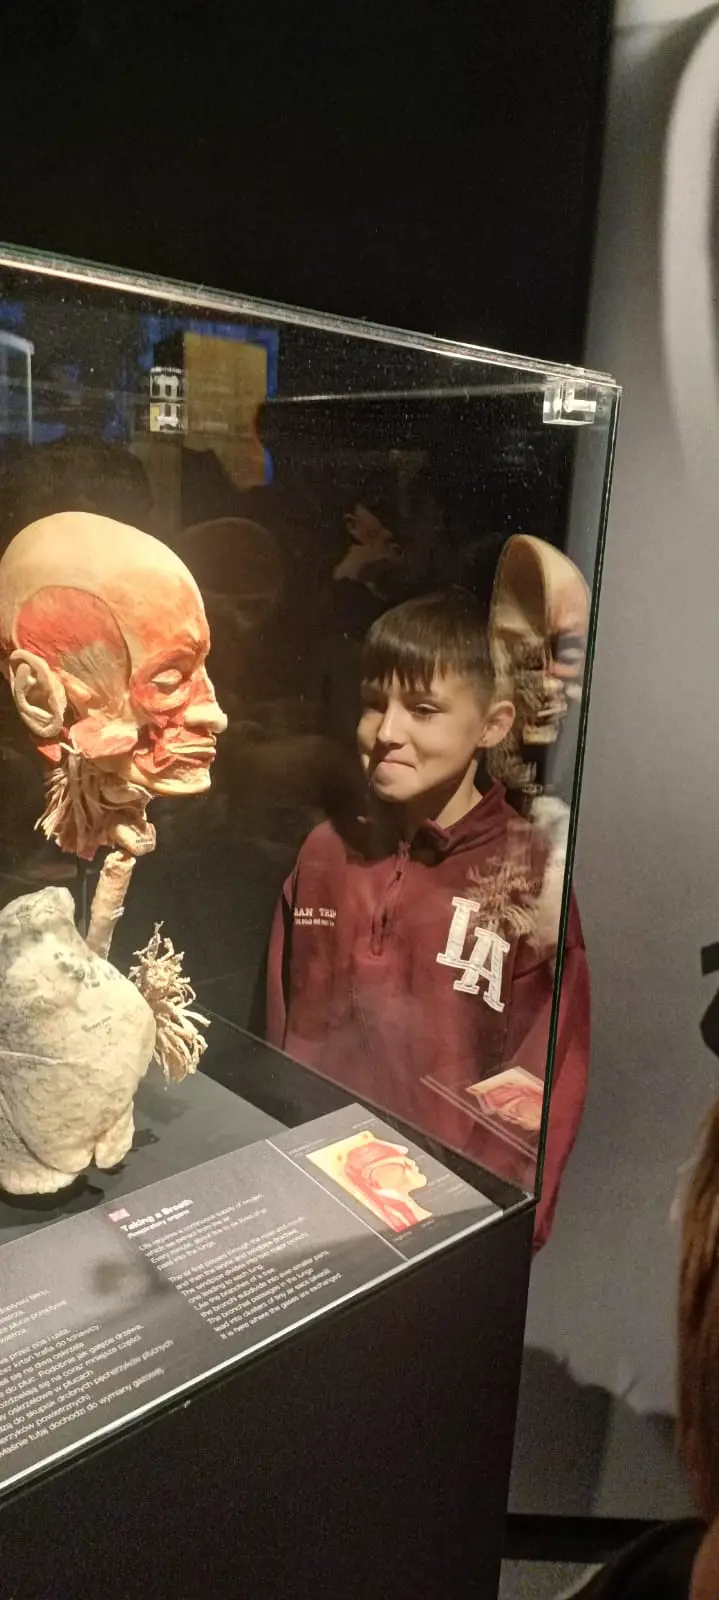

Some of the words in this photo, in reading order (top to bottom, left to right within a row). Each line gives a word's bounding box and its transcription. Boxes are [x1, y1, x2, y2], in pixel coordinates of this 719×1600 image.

[436, 896, 511, 1013] LA
[119, 1215, 155, 1231] Taking
[200, 1282, 226, 1297] leading
[219, 1280, 250, 1297] branches
[211, 1295, 237, 1312] bronchi
[220, 1299, 251, 1318] bronchial
[248, 1311, 269, 1324] where
